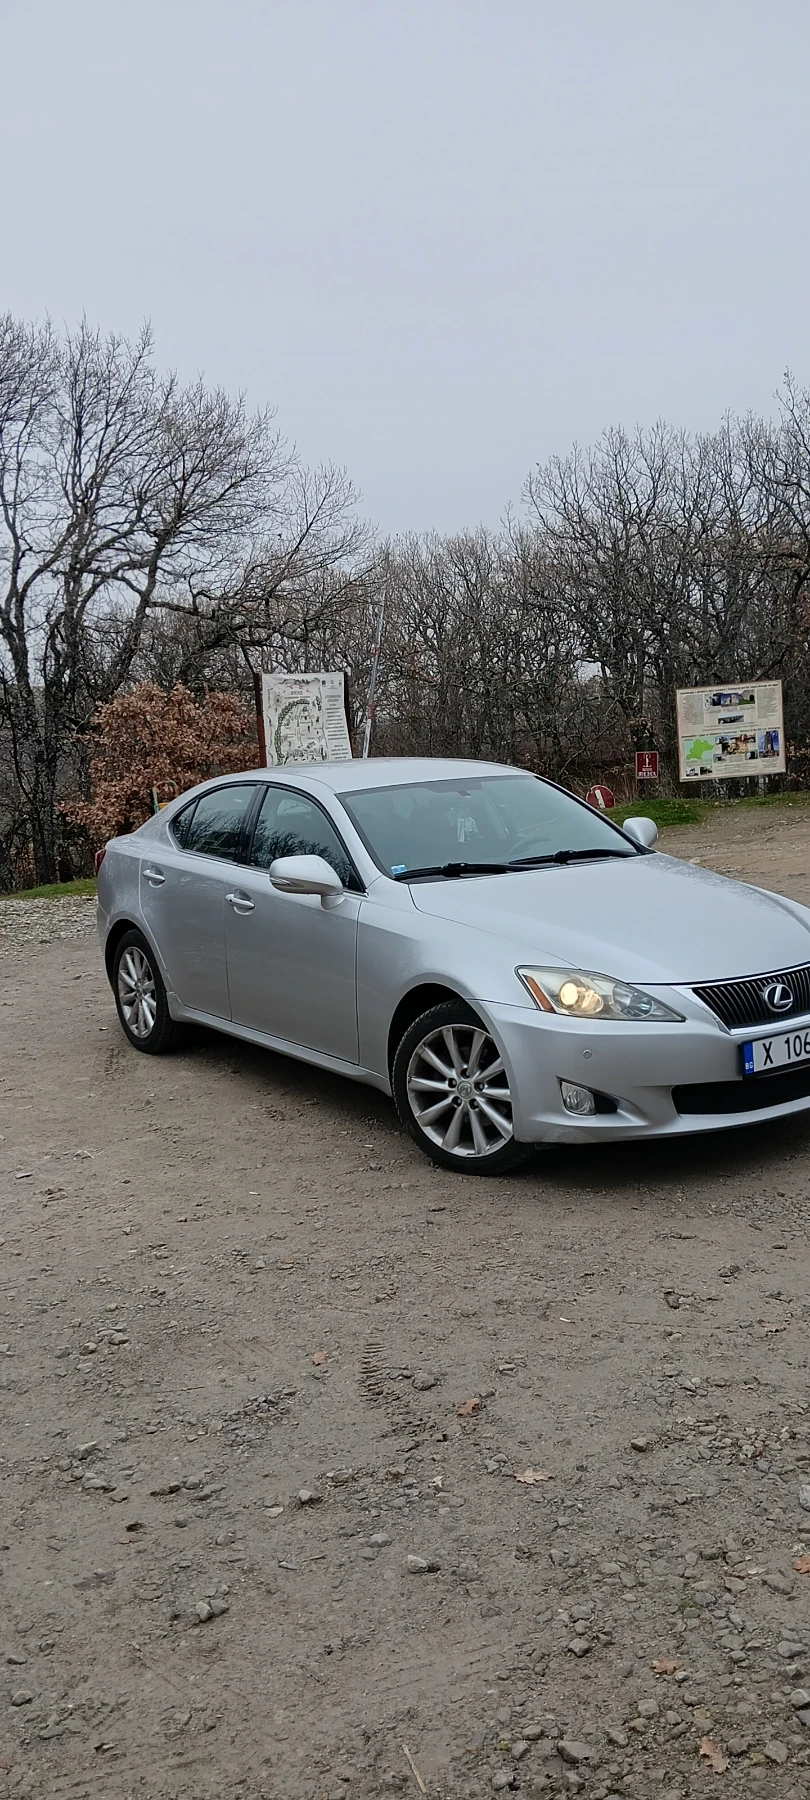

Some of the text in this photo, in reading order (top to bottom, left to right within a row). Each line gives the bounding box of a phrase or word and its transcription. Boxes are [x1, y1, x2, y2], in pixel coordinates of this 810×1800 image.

[762, 1032, 810, 1067] X 106
[745, 1061, 754, 1070] BG
